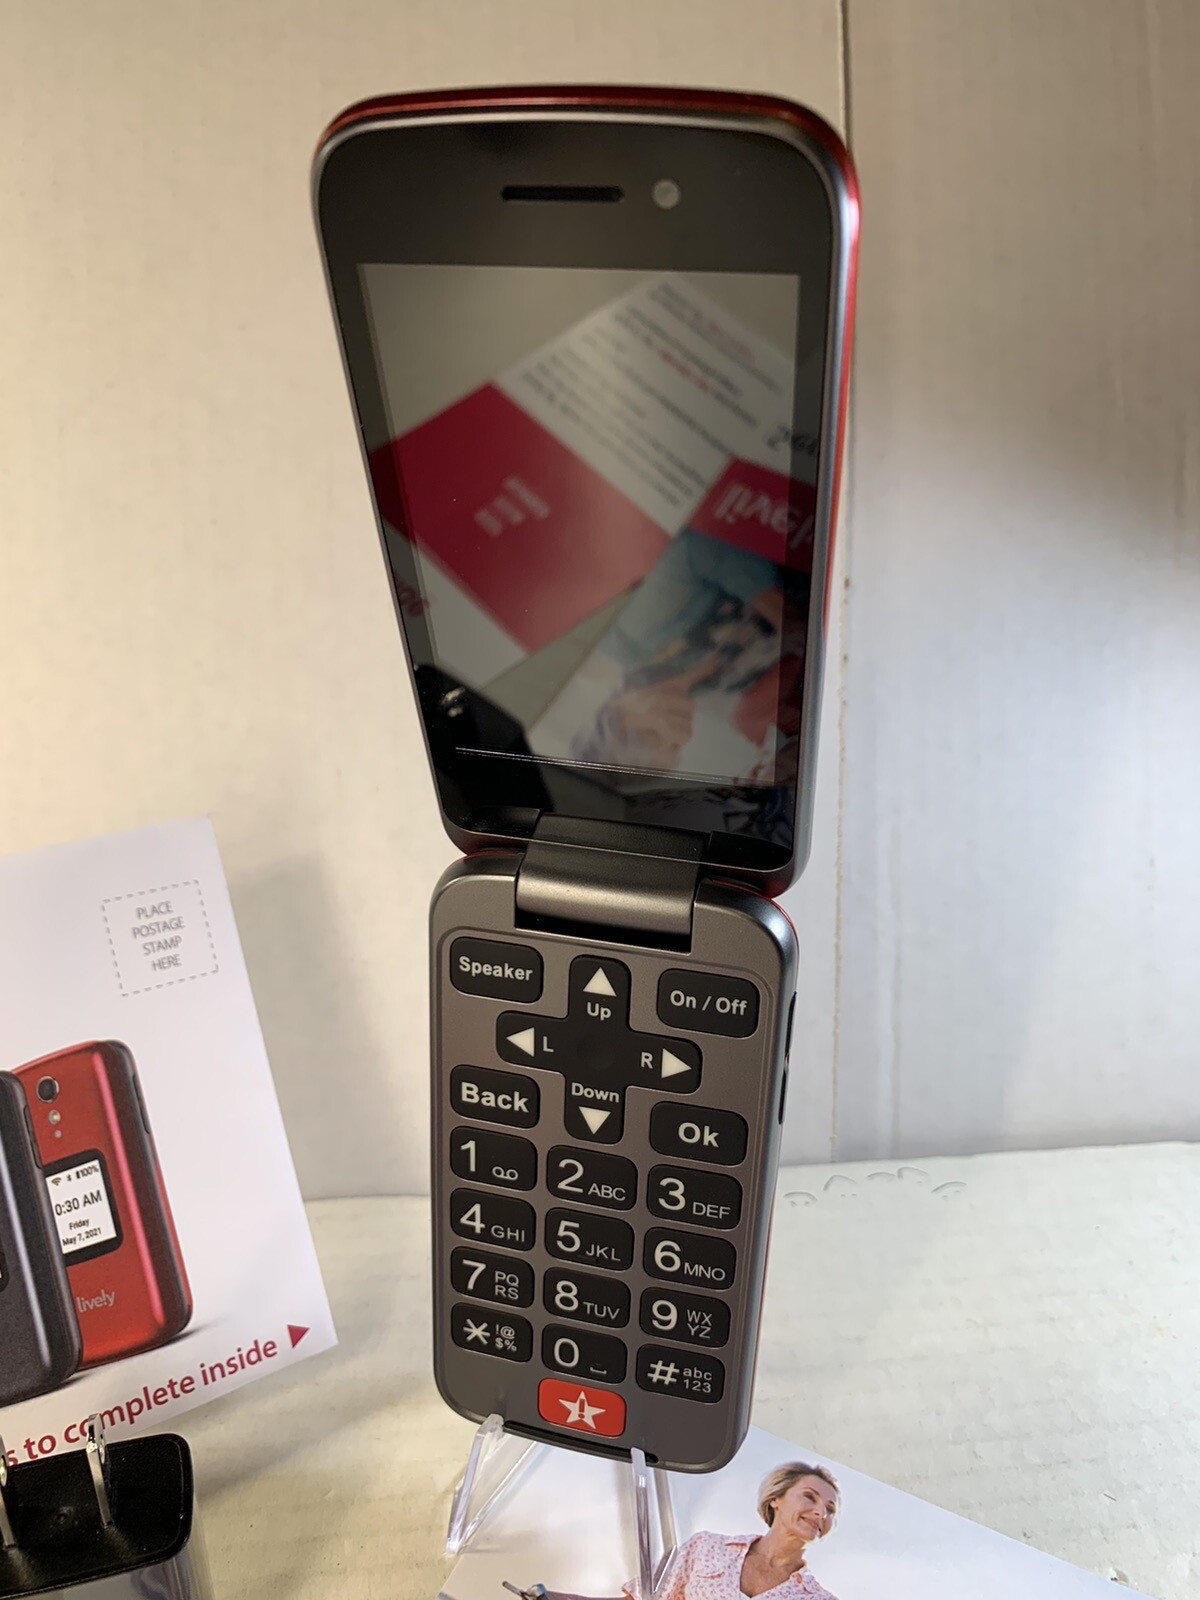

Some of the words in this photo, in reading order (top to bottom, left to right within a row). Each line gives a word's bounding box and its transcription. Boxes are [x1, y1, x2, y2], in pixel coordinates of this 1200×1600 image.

[136, 900, 174, 919] PLACE
[132, 916, 186, 939] POSTAGE
[142, 935, 182, 956] STAMP
[151, 954, 182, 971] HERE
[460, 956, 532, 980] Speaker
[587, 1002, 611, 1020] Up
[671, 990, 696, 1008] On
[716, 997, 747, 1015] Off
[543, 1036, 553, 1052] L
[641, 1052, 652, 1068] R
[462, 1082, 528, 1112] Back
[572, 1083, 619, 1102] Down
[679, 1123, 718, 1147] Ok
[461, 1141, 475, 1171] 1
[558, 1159, 583, 1193] 2
[588, 1183, 625, 1201] ABC
[83, 1190, 102, 1207] AM
[659, 1178, 685, 1210] 3
[693, 1202, 730, 1218] DEF
[68, 1219, 90, 1230] Friday
[460, 1204, 485, 1233] 4
[491, 1226, 524, 1242] GHI
[62, 1236, 77, 1246] May
[84, 1227, 102, 1239] 2021
[557, 1220, 580, 1252] 5
[586, 1244, 620, 1261] JKL
[655, 1241, 680, 1271] 6
[684, 1262, 725, 1280] MNO
[463, 1260, 486, 1289] 7
[494, 1271, 519, 1286] PQ
[76, 1290, 115, 1313] lively
[494, 1286, 519, 1300] RS
[555, 1281, 578, 1310] 8
[583, 1302, 619, 1319] TUV
[652, 1300, 677, 1330] 9
[687, 1309, 713, 1325] WX
[687, 1326, 712, 1339] YZ
[684, 1366, 713, 1382] abc
[685, 1380, 712, 1395] 123
[23, 1434, 57, 1461] to
[199, 1339, 278, 1386] inside
